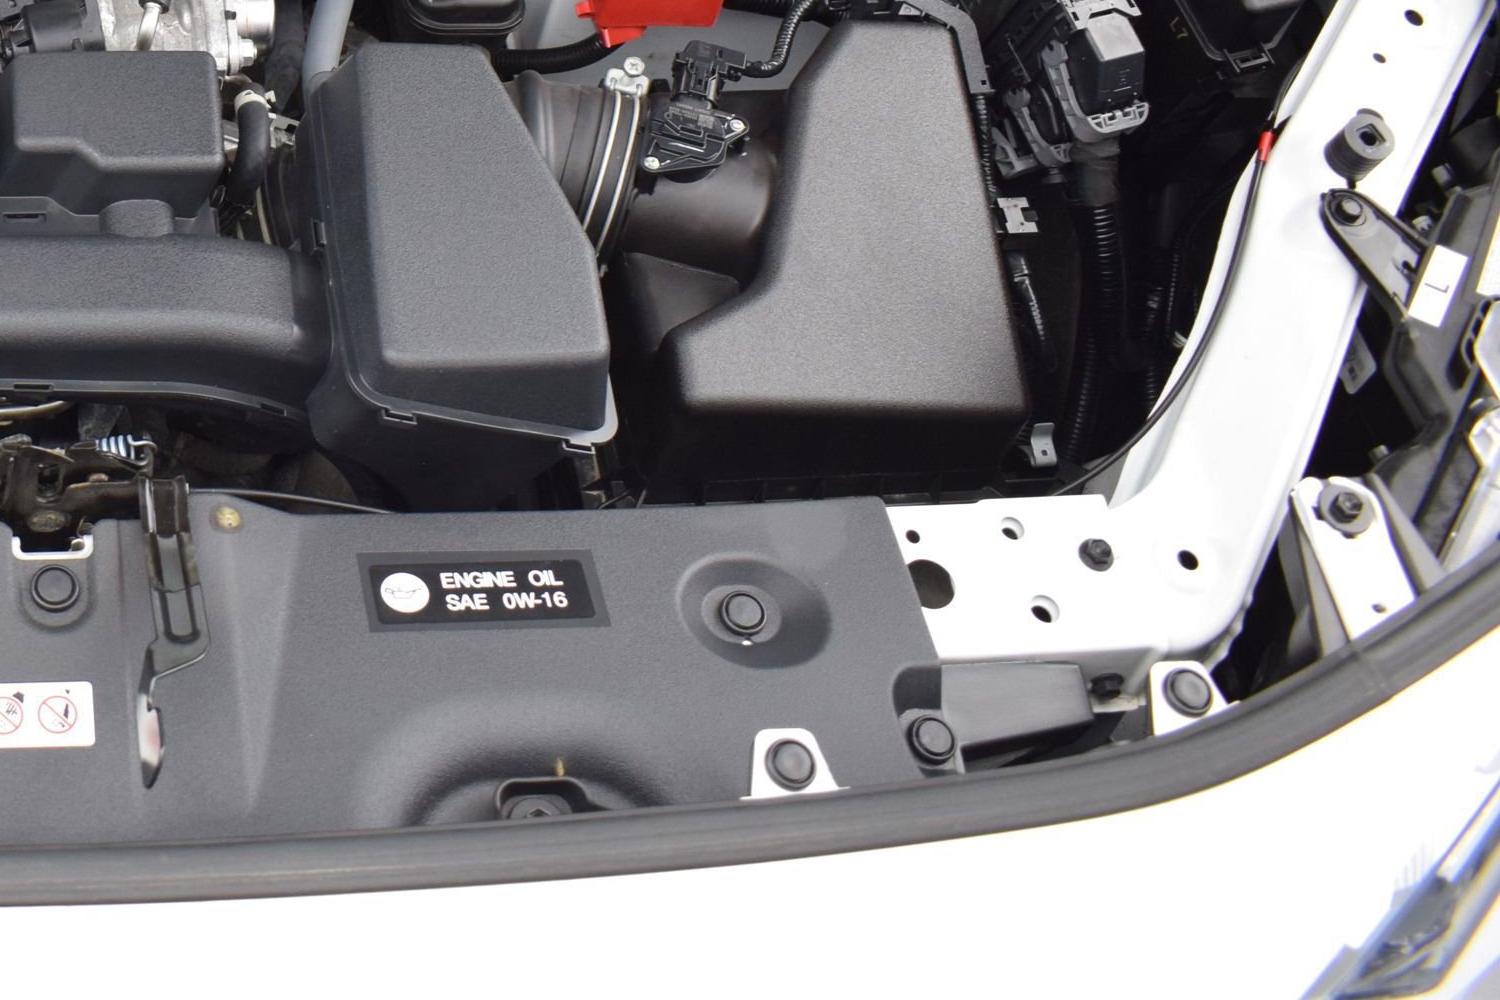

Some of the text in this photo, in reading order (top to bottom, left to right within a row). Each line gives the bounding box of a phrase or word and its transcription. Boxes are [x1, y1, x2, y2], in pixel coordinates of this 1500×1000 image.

[439, 569, 564, 589] ENGINE OIL
[445, 590, 569, 612] SAE 0W-16
